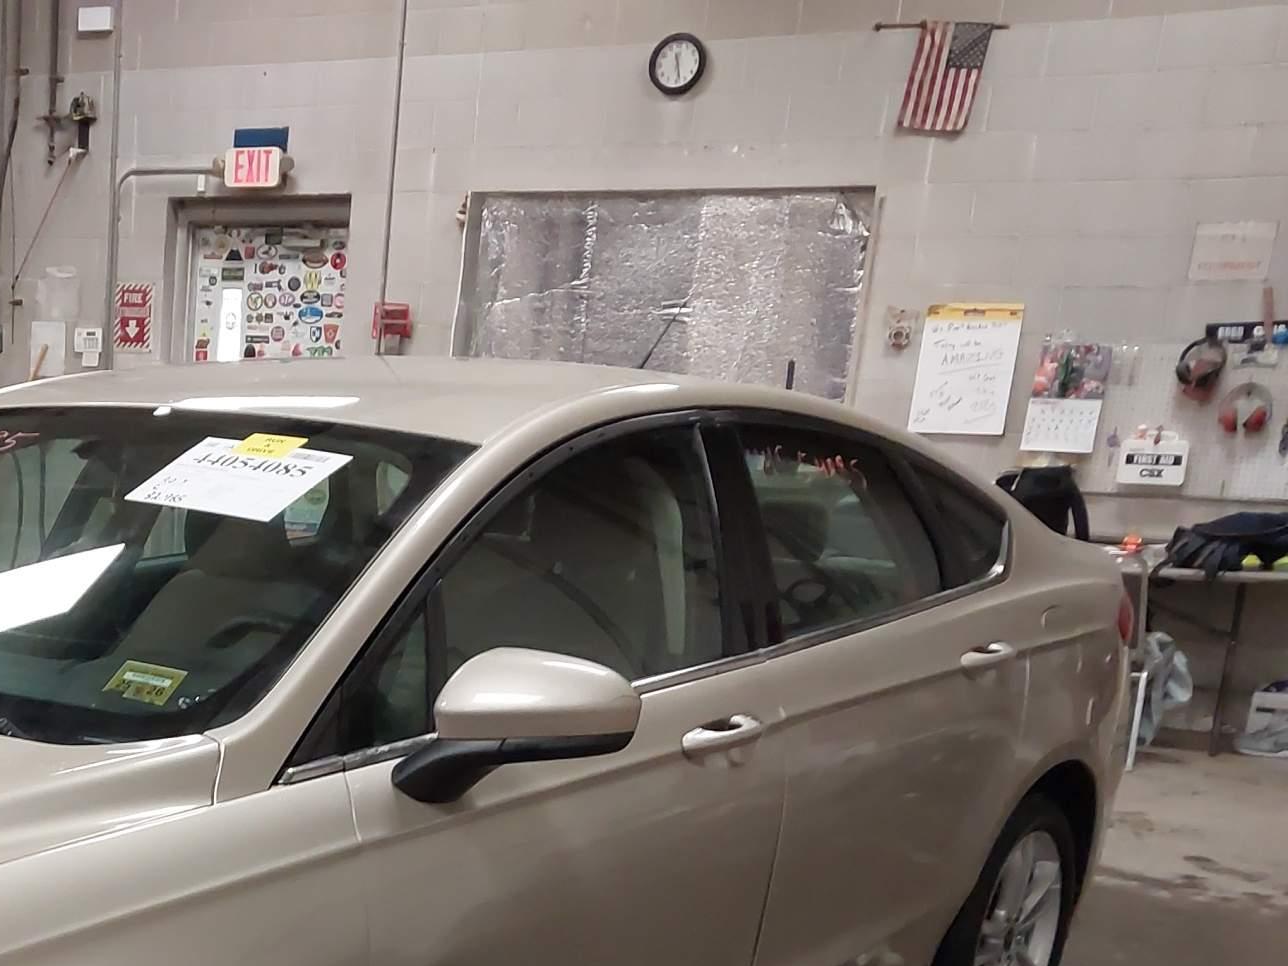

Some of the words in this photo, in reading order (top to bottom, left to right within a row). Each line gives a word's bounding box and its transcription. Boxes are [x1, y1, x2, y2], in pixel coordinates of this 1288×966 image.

[233, 149, 273, 184] EXIT
[123, 292, 144, 304] FIRE
[193, 453, 314, 478] 44054085
[1133, 454, 1158, 465] FIRST
[1159, 455, 1175, 466] AID
